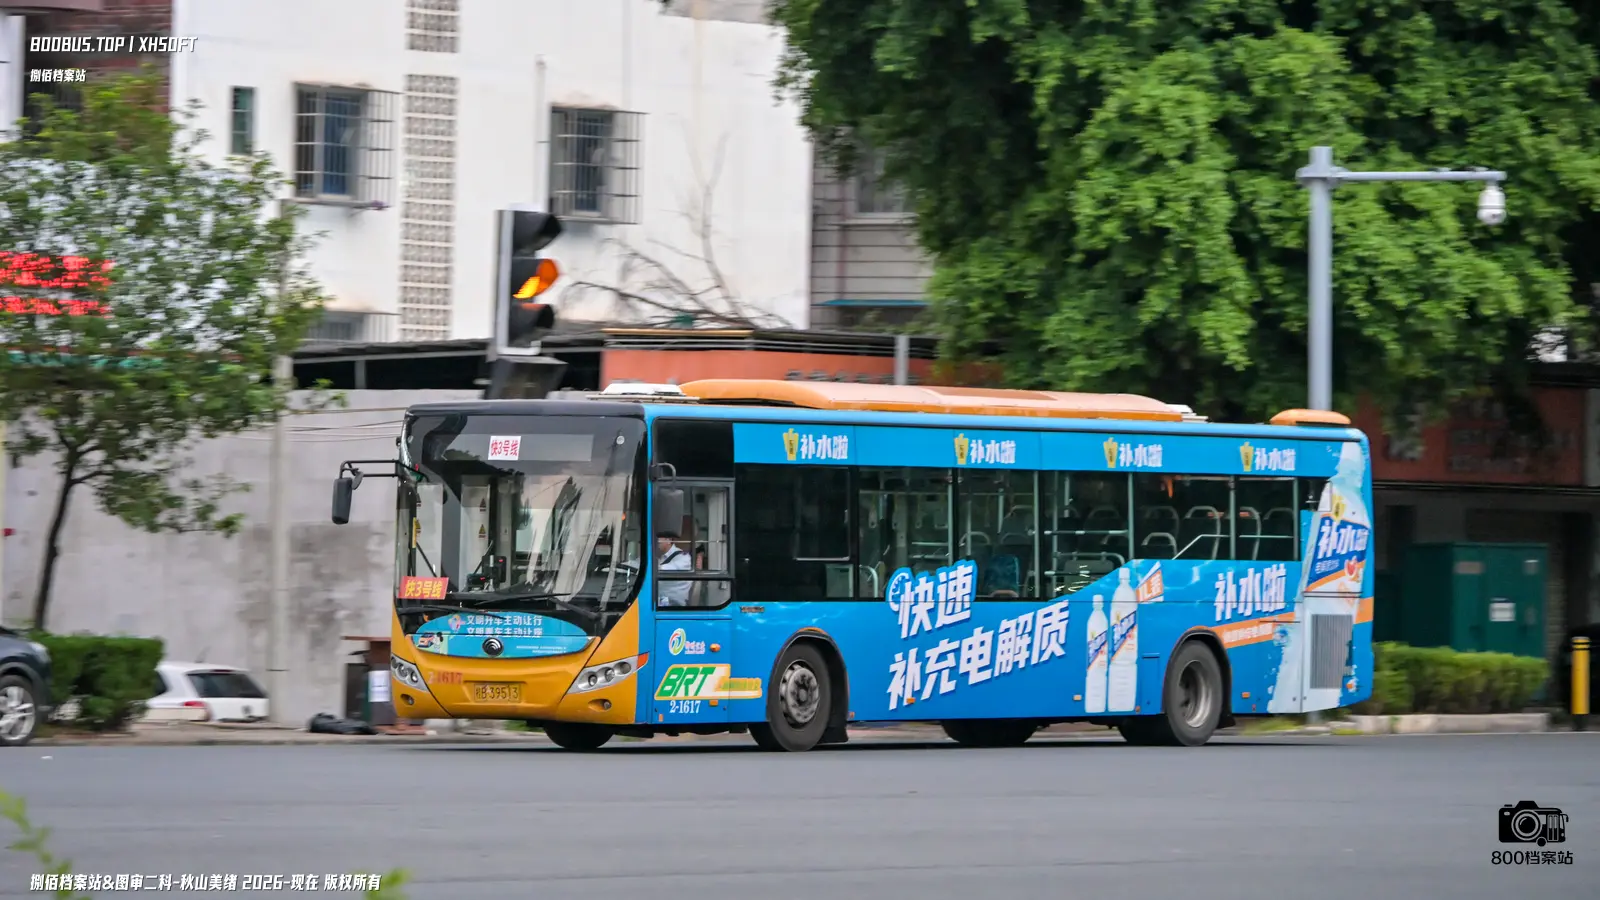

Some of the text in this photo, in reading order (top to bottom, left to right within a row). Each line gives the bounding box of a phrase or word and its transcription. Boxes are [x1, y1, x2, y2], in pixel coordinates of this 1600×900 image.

[490, 439, 519, 456] 快3号线
[800, 434, 849, 460] 补水啦
[970, 439, 1017, 464] 补水啦
[1119, 443, 1163, 468] 补水啦
[1254, 447, 1296, 472] 补水啦
[404, 579, 443, 599] 快3号线
[1213, 563, 1287, 622] 补水啦
[897, 564, 974, 640] 快速
[886, 599, 1070, 711] 补充电解质
[656, 666, 717, 697] BRT
[669, 700, 702, 714] 2-1617
